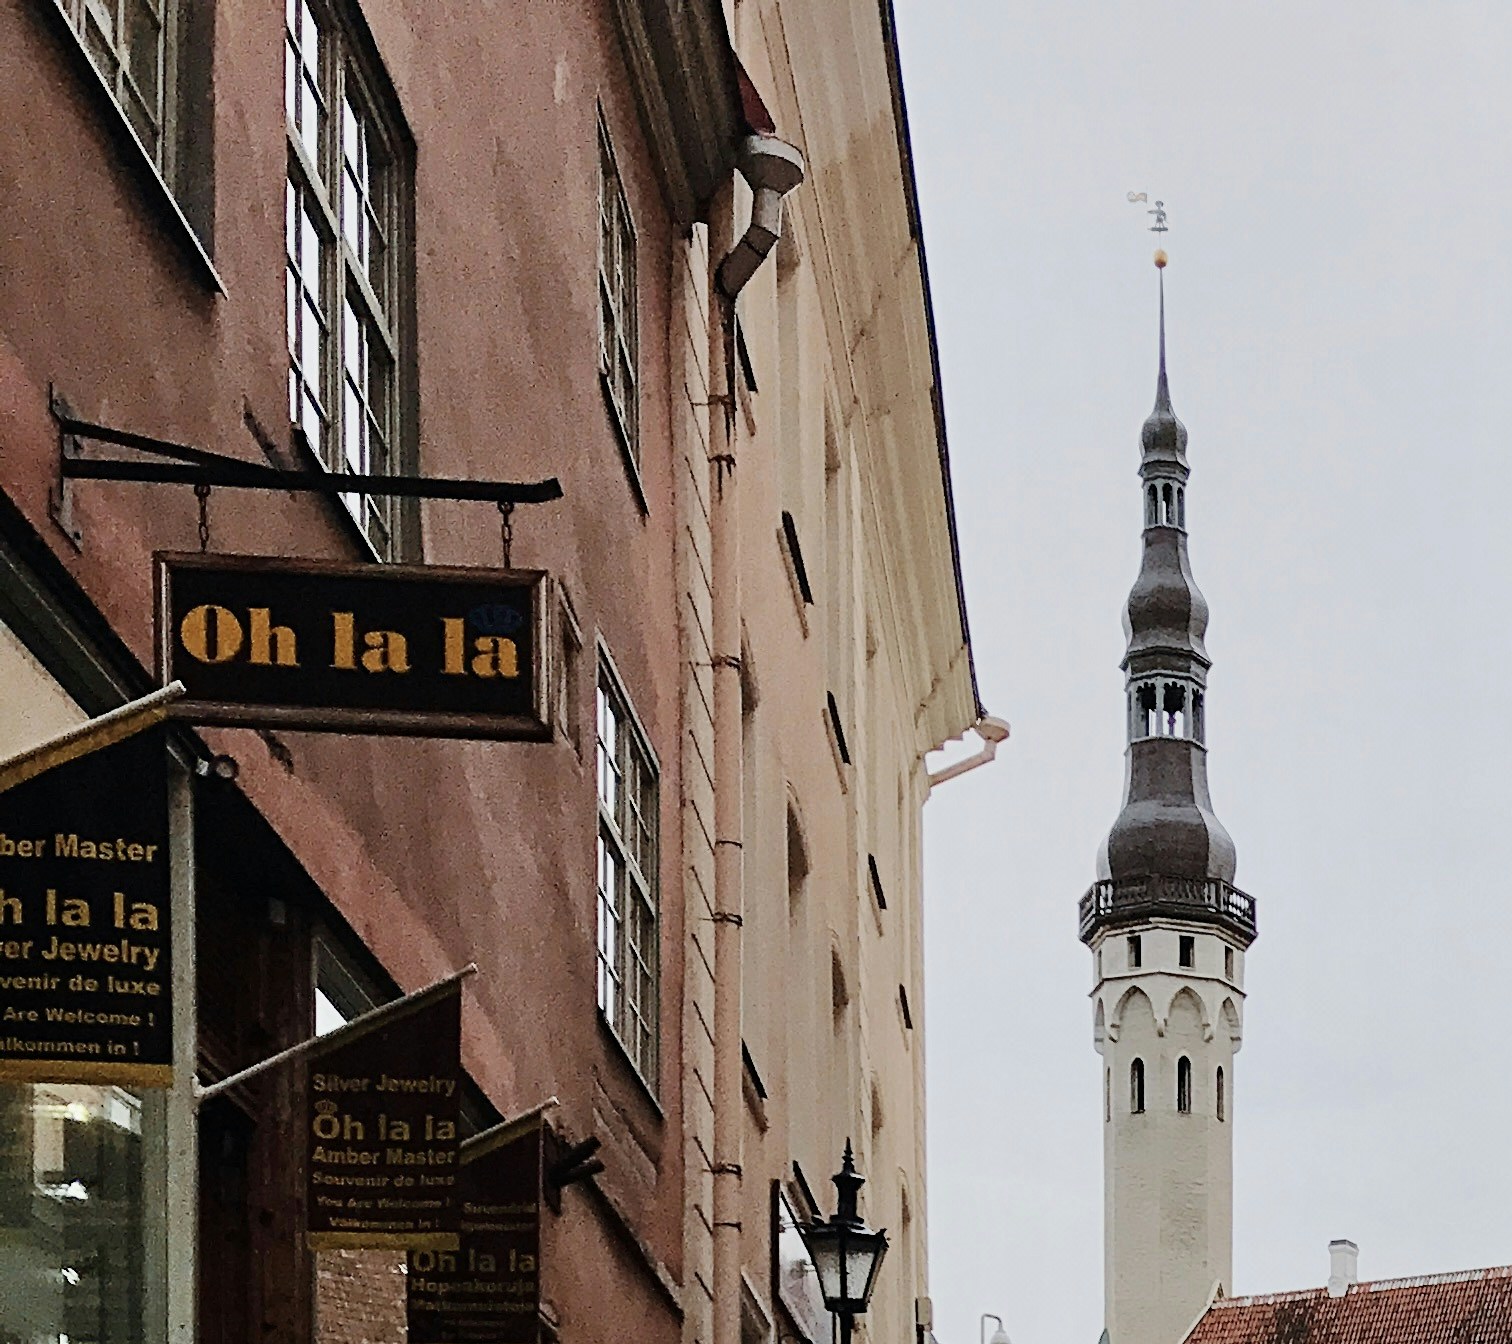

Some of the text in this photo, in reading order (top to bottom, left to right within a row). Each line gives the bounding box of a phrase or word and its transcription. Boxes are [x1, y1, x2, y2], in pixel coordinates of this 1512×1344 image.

[180, 603, 521, 679] Oh la la
[55, 832, 159, 862] Master
[45, 887, 91, 927] la
[113, 890, 160, 931] la
[0, 935, 161, 971] er Jewelry
[68, 973, 99, 993] de
[107, 974, 162, 997] luxe
[45, 1006, 142, 1027] Welcome
[107, 1039, 127, 1056] in
[312, 1072, 456, 1098] Silver Jewelry
[312, 1112, 457, 1142] Oh la la
[312, 1145, 457, 1166] Amber Master
[468, 1247, 497, 1273] la
[509, 1247, 536, 1273] la
